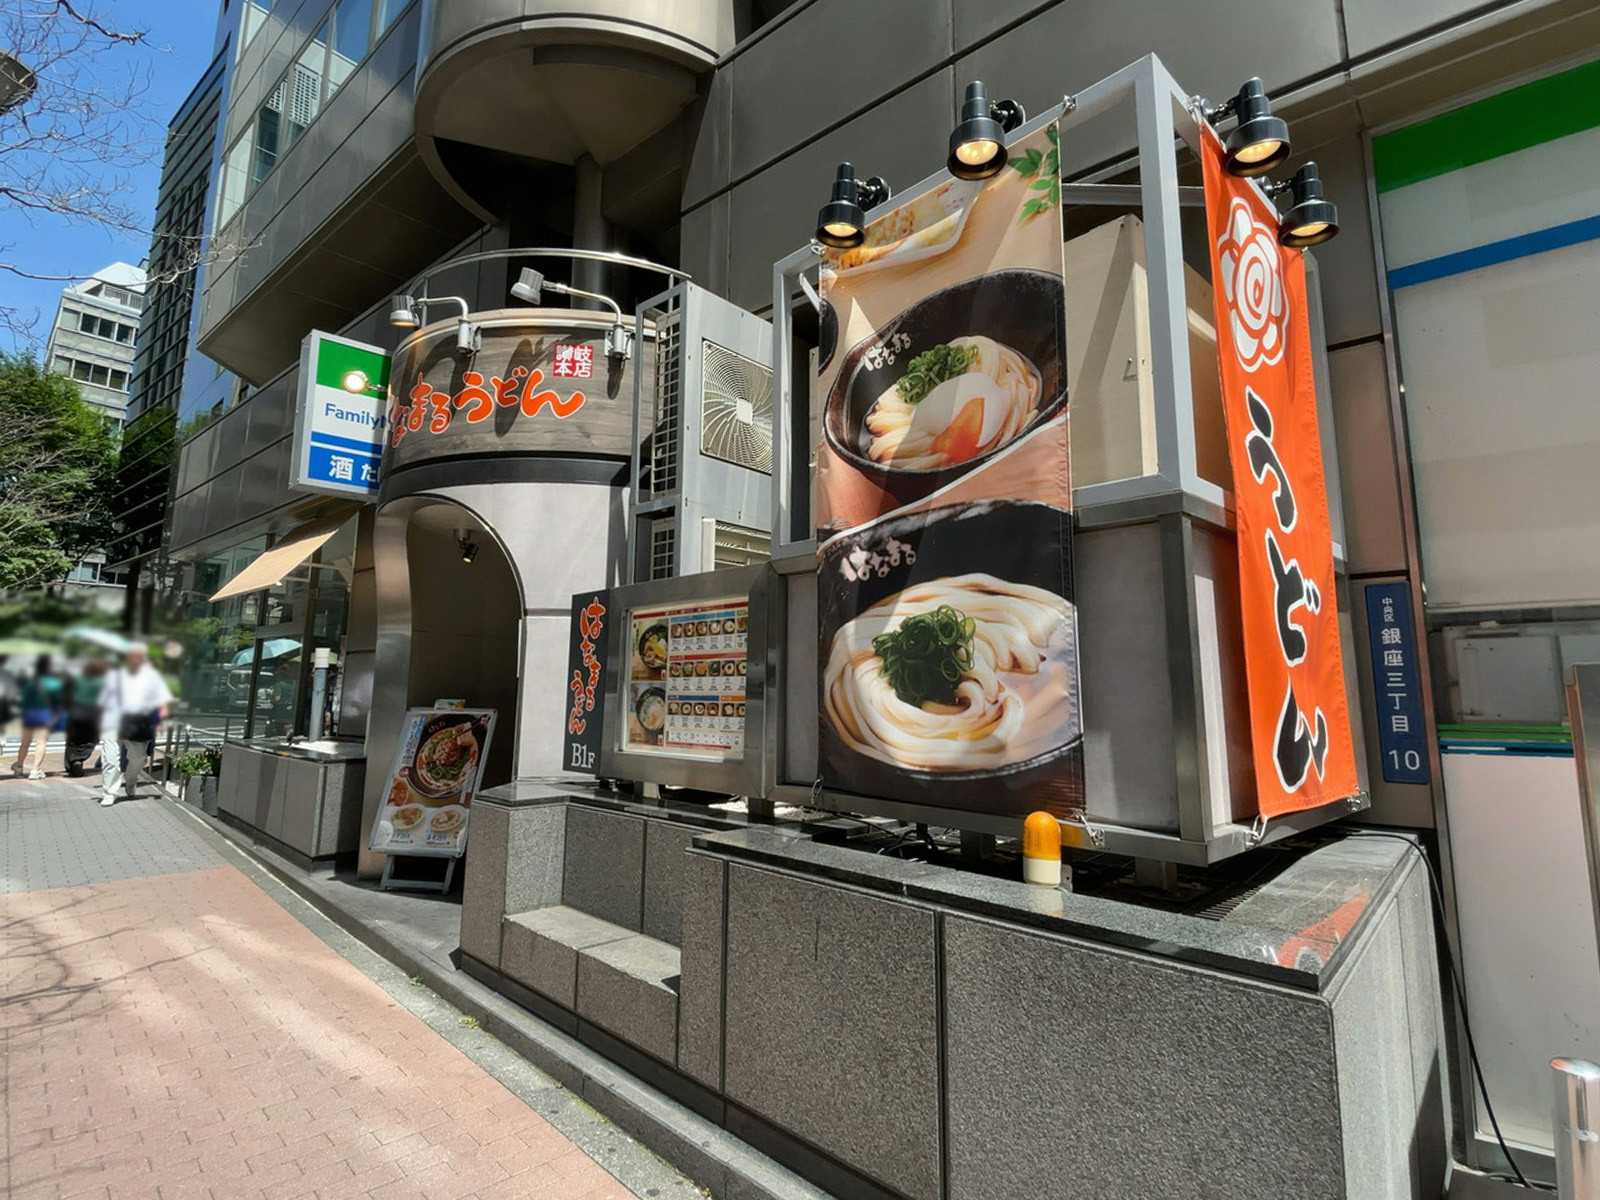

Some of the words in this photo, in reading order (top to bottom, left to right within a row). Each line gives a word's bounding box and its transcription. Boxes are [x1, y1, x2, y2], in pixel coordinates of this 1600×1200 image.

[554, 360, 592, 378] 本店
[863, 332, 912, 372] はなまる
[383, 365, 586, 447] なまるうどん
[328, 454, 355, 481] 酒
[360, 462, 380, 482] た
[841, 536, 916, 582] はなまる
[1245, 385, 1329, 794] うどん
[1381, 596, 1394, 622] 中央区
[579, 596, 606, 711] はなまる
[1381, 627, 1410, 733] 銀座三丁目
[568, 669, 588, 735] うどん
[570, 743, 596, 769] B1F
[1388, 749, 1421, 771] 10
